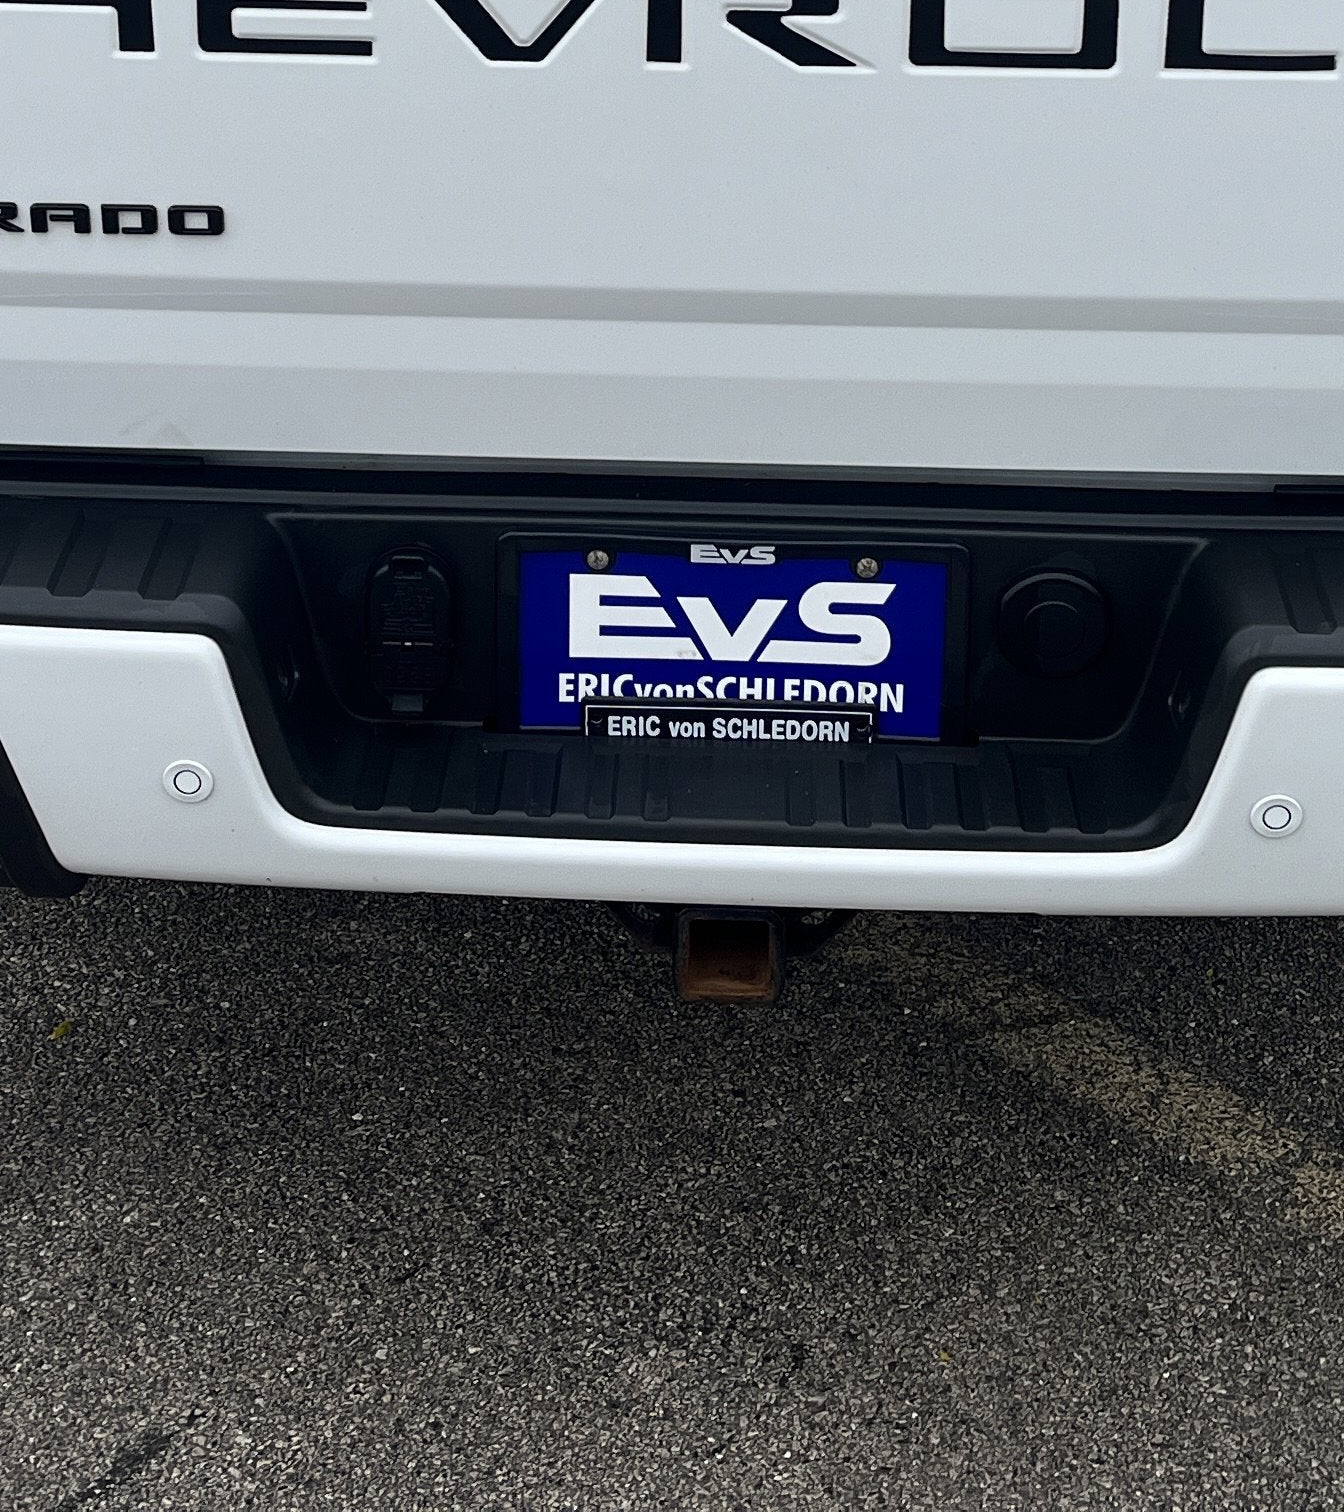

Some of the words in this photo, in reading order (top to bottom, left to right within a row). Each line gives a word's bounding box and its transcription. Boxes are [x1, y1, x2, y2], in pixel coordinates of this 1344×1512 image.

[607, 715, 661, 737] ERIC
[668, 720, 706, 738] von
[712, 717, 850, 743] SCHLEDORN
